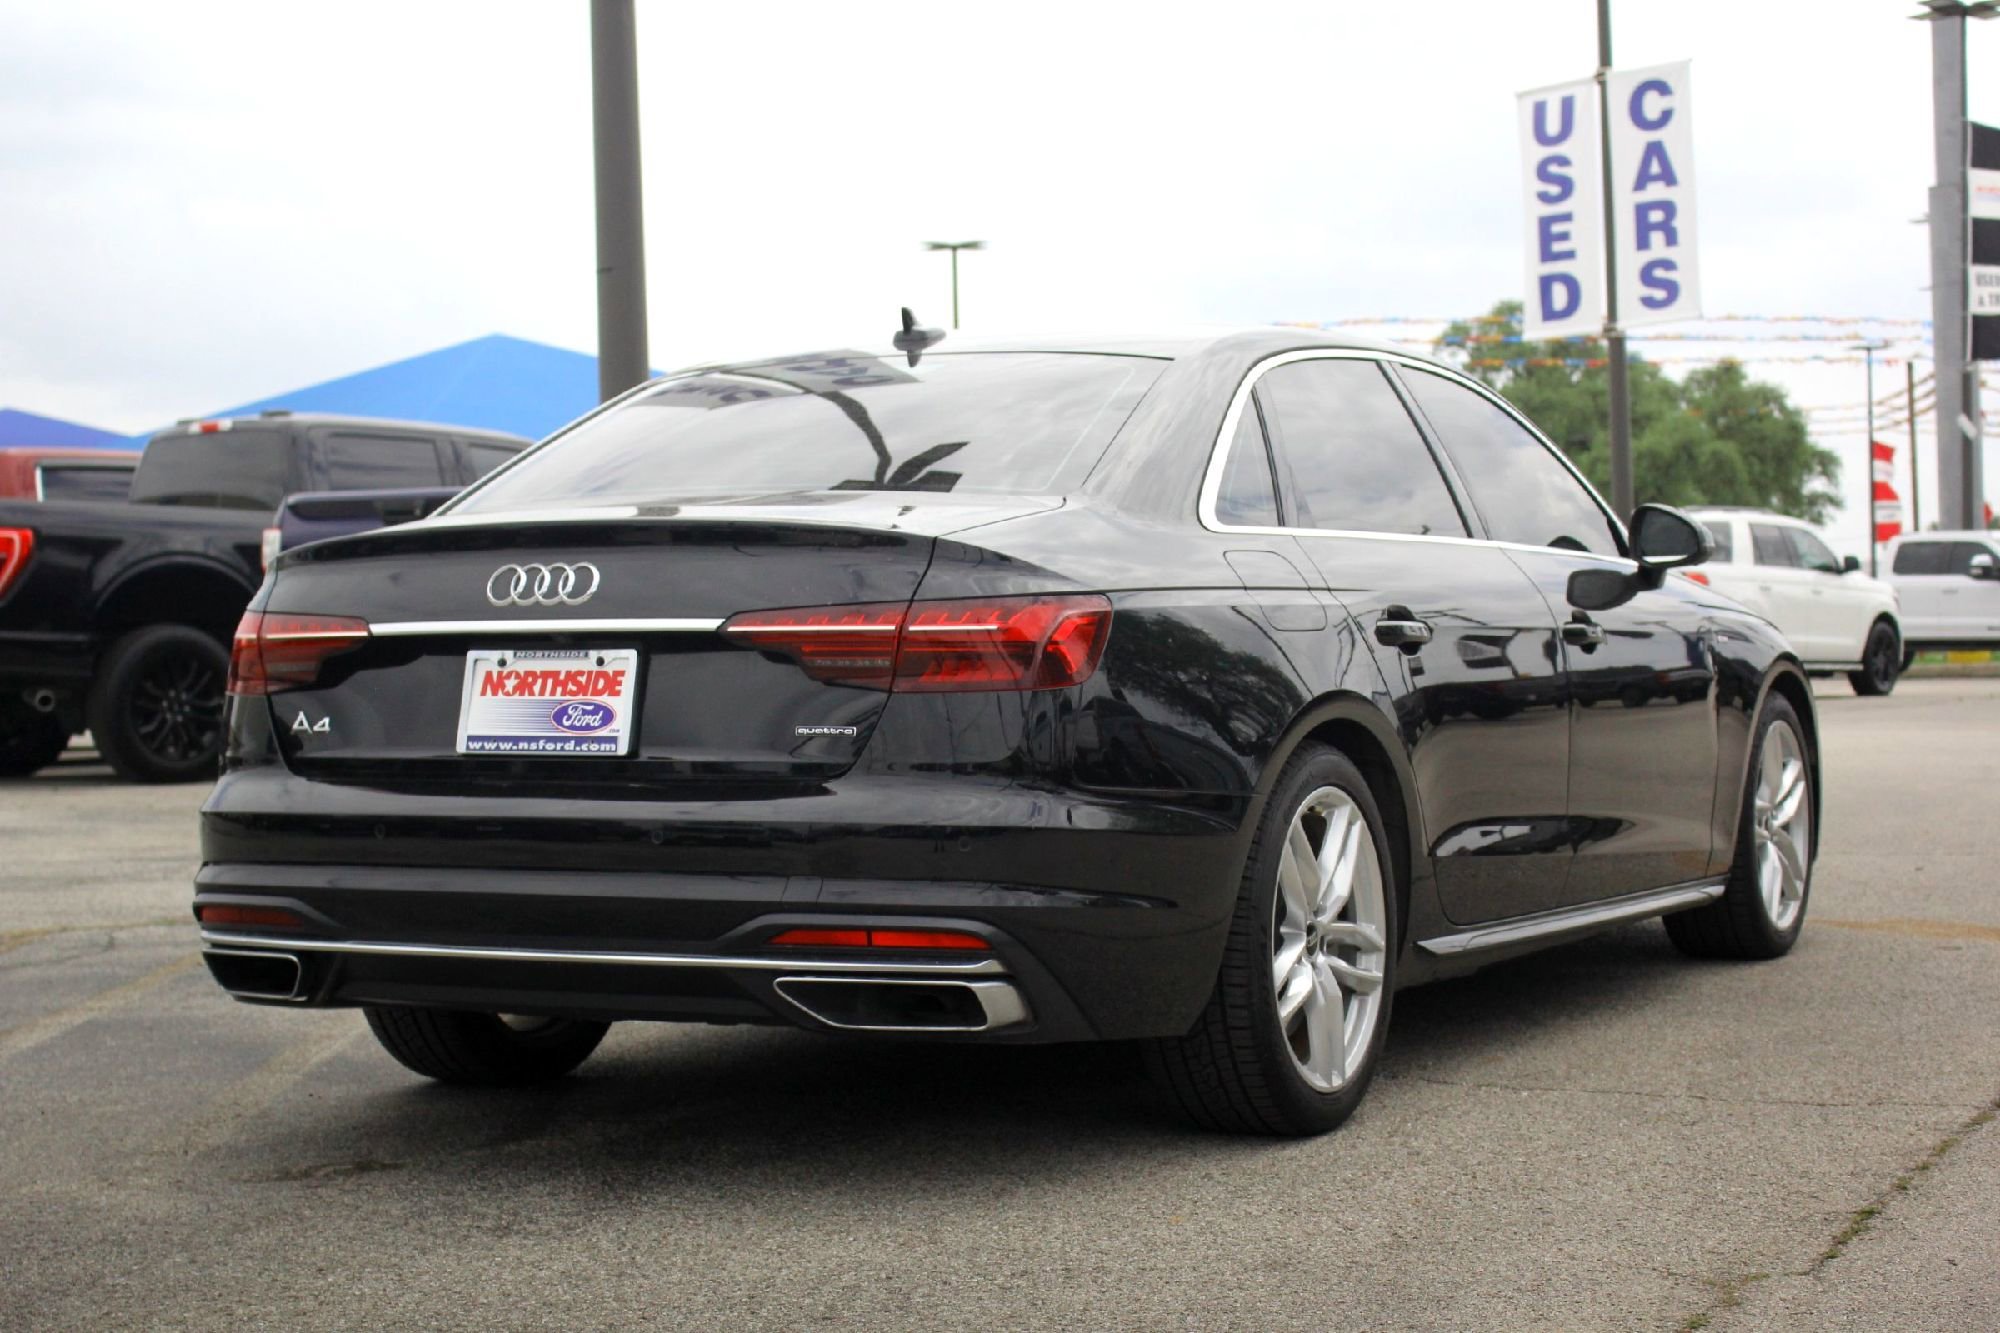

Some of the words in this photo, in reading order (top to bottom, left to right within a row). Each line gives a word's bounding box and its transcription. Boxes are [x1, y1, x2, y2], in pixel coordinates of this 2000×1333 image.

[1628, 78, 1681, 309] CARS
[1533, 95, 1581, 322] USED
[480, 670, 626, 697] NORTHSIDE
[290, 711, 331, 734] A4
[562, 704, 603, 727] Ford
[797, 727, 853, 735] quattro
[467, 740, 617, 751] www.nsford.com
